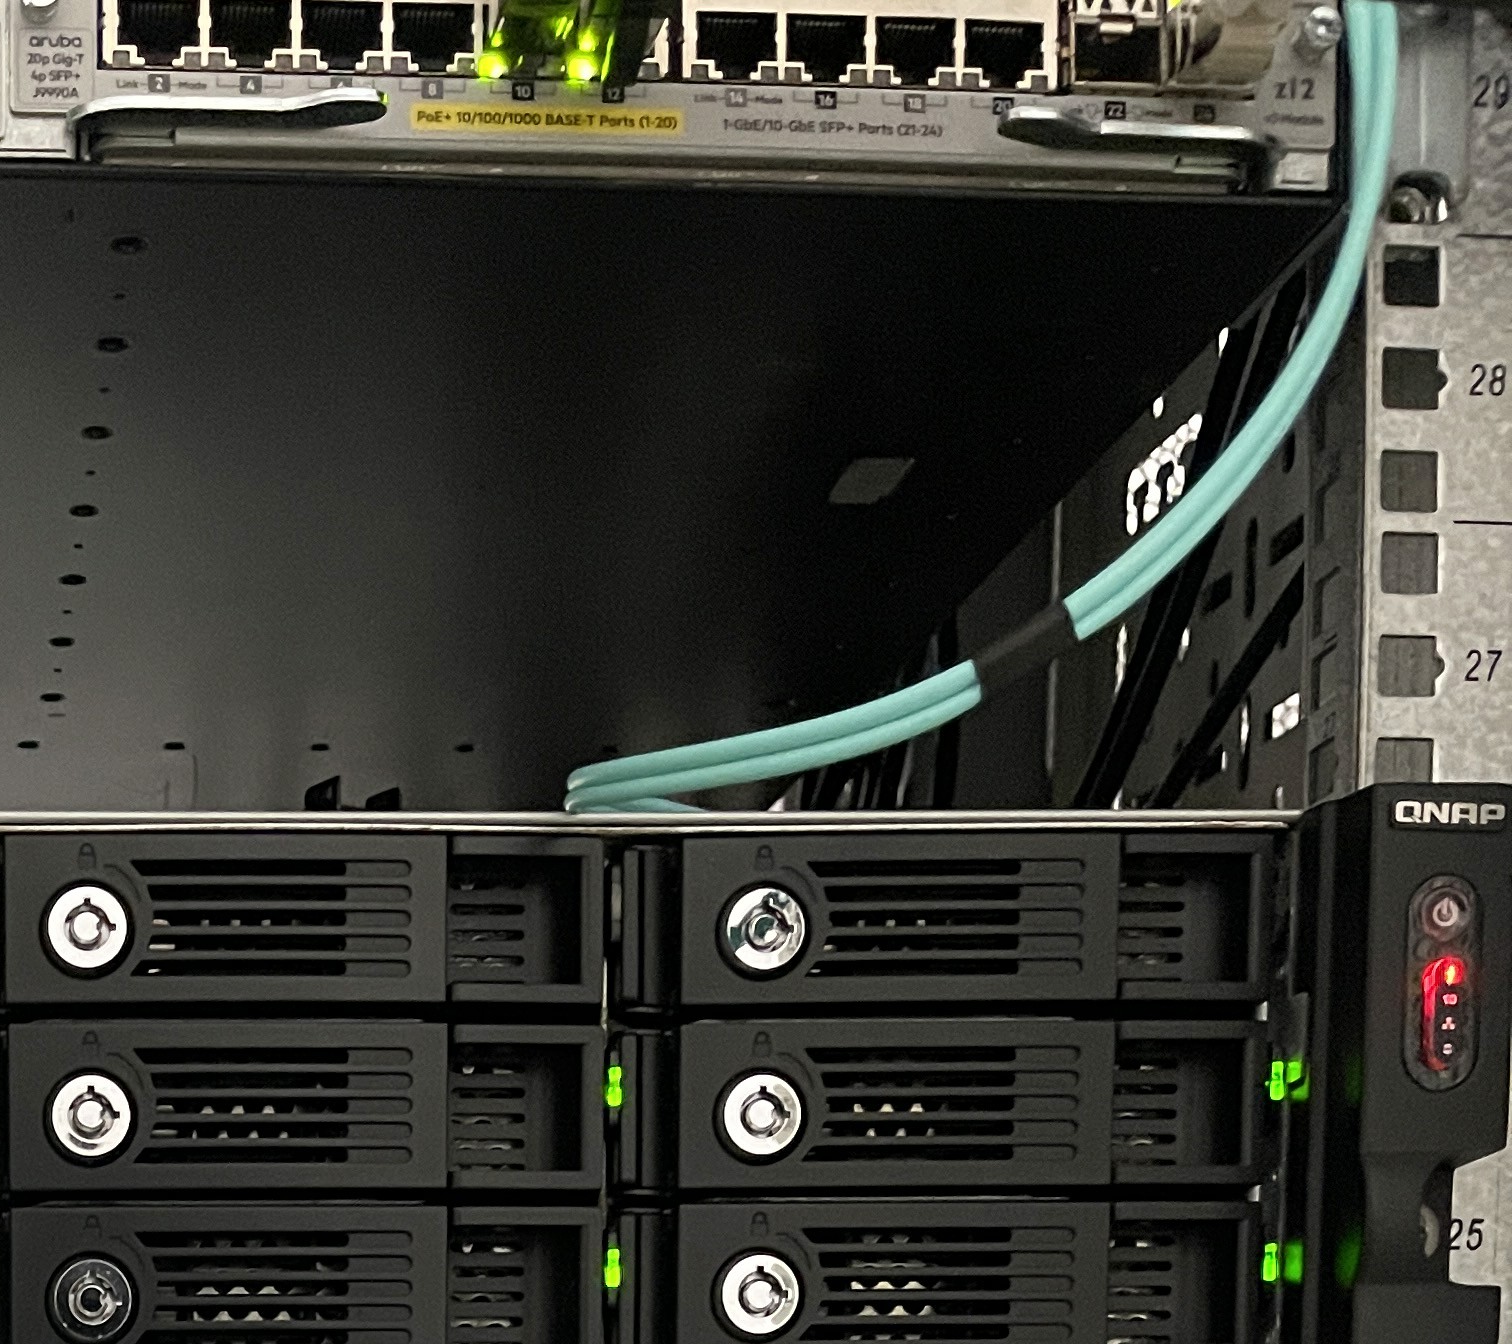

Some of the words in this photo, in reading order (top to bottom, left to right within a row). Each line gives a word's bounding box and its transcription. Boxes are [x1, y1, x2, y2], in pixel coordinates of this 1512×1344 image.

[29, 34, 82, 47] aruba
[27, 53, 50, 66] 20p
[49, 71, 80, 82] SFP+
[515, 84, 531, 98] 10
[606, 87, 622, 101] 12
[1473, 75, 1510, 110] 29
[416, 110, 451, 124] PoE+
[456, 110, 540, 127] 10/100/1000
[599, 114, 635, 129] Ports
[638, 115, 678, 131] (1-20)
[818, 119, 854, 133] SFP+
[858, 121, 893, 135] Ports
[1469, 363, 1508, 398] 28
[1464, 650, 1503, 683] 27
[1395, 800, 1506, 824] QNAP
[1448, 1218, 1484, 1251] 25
